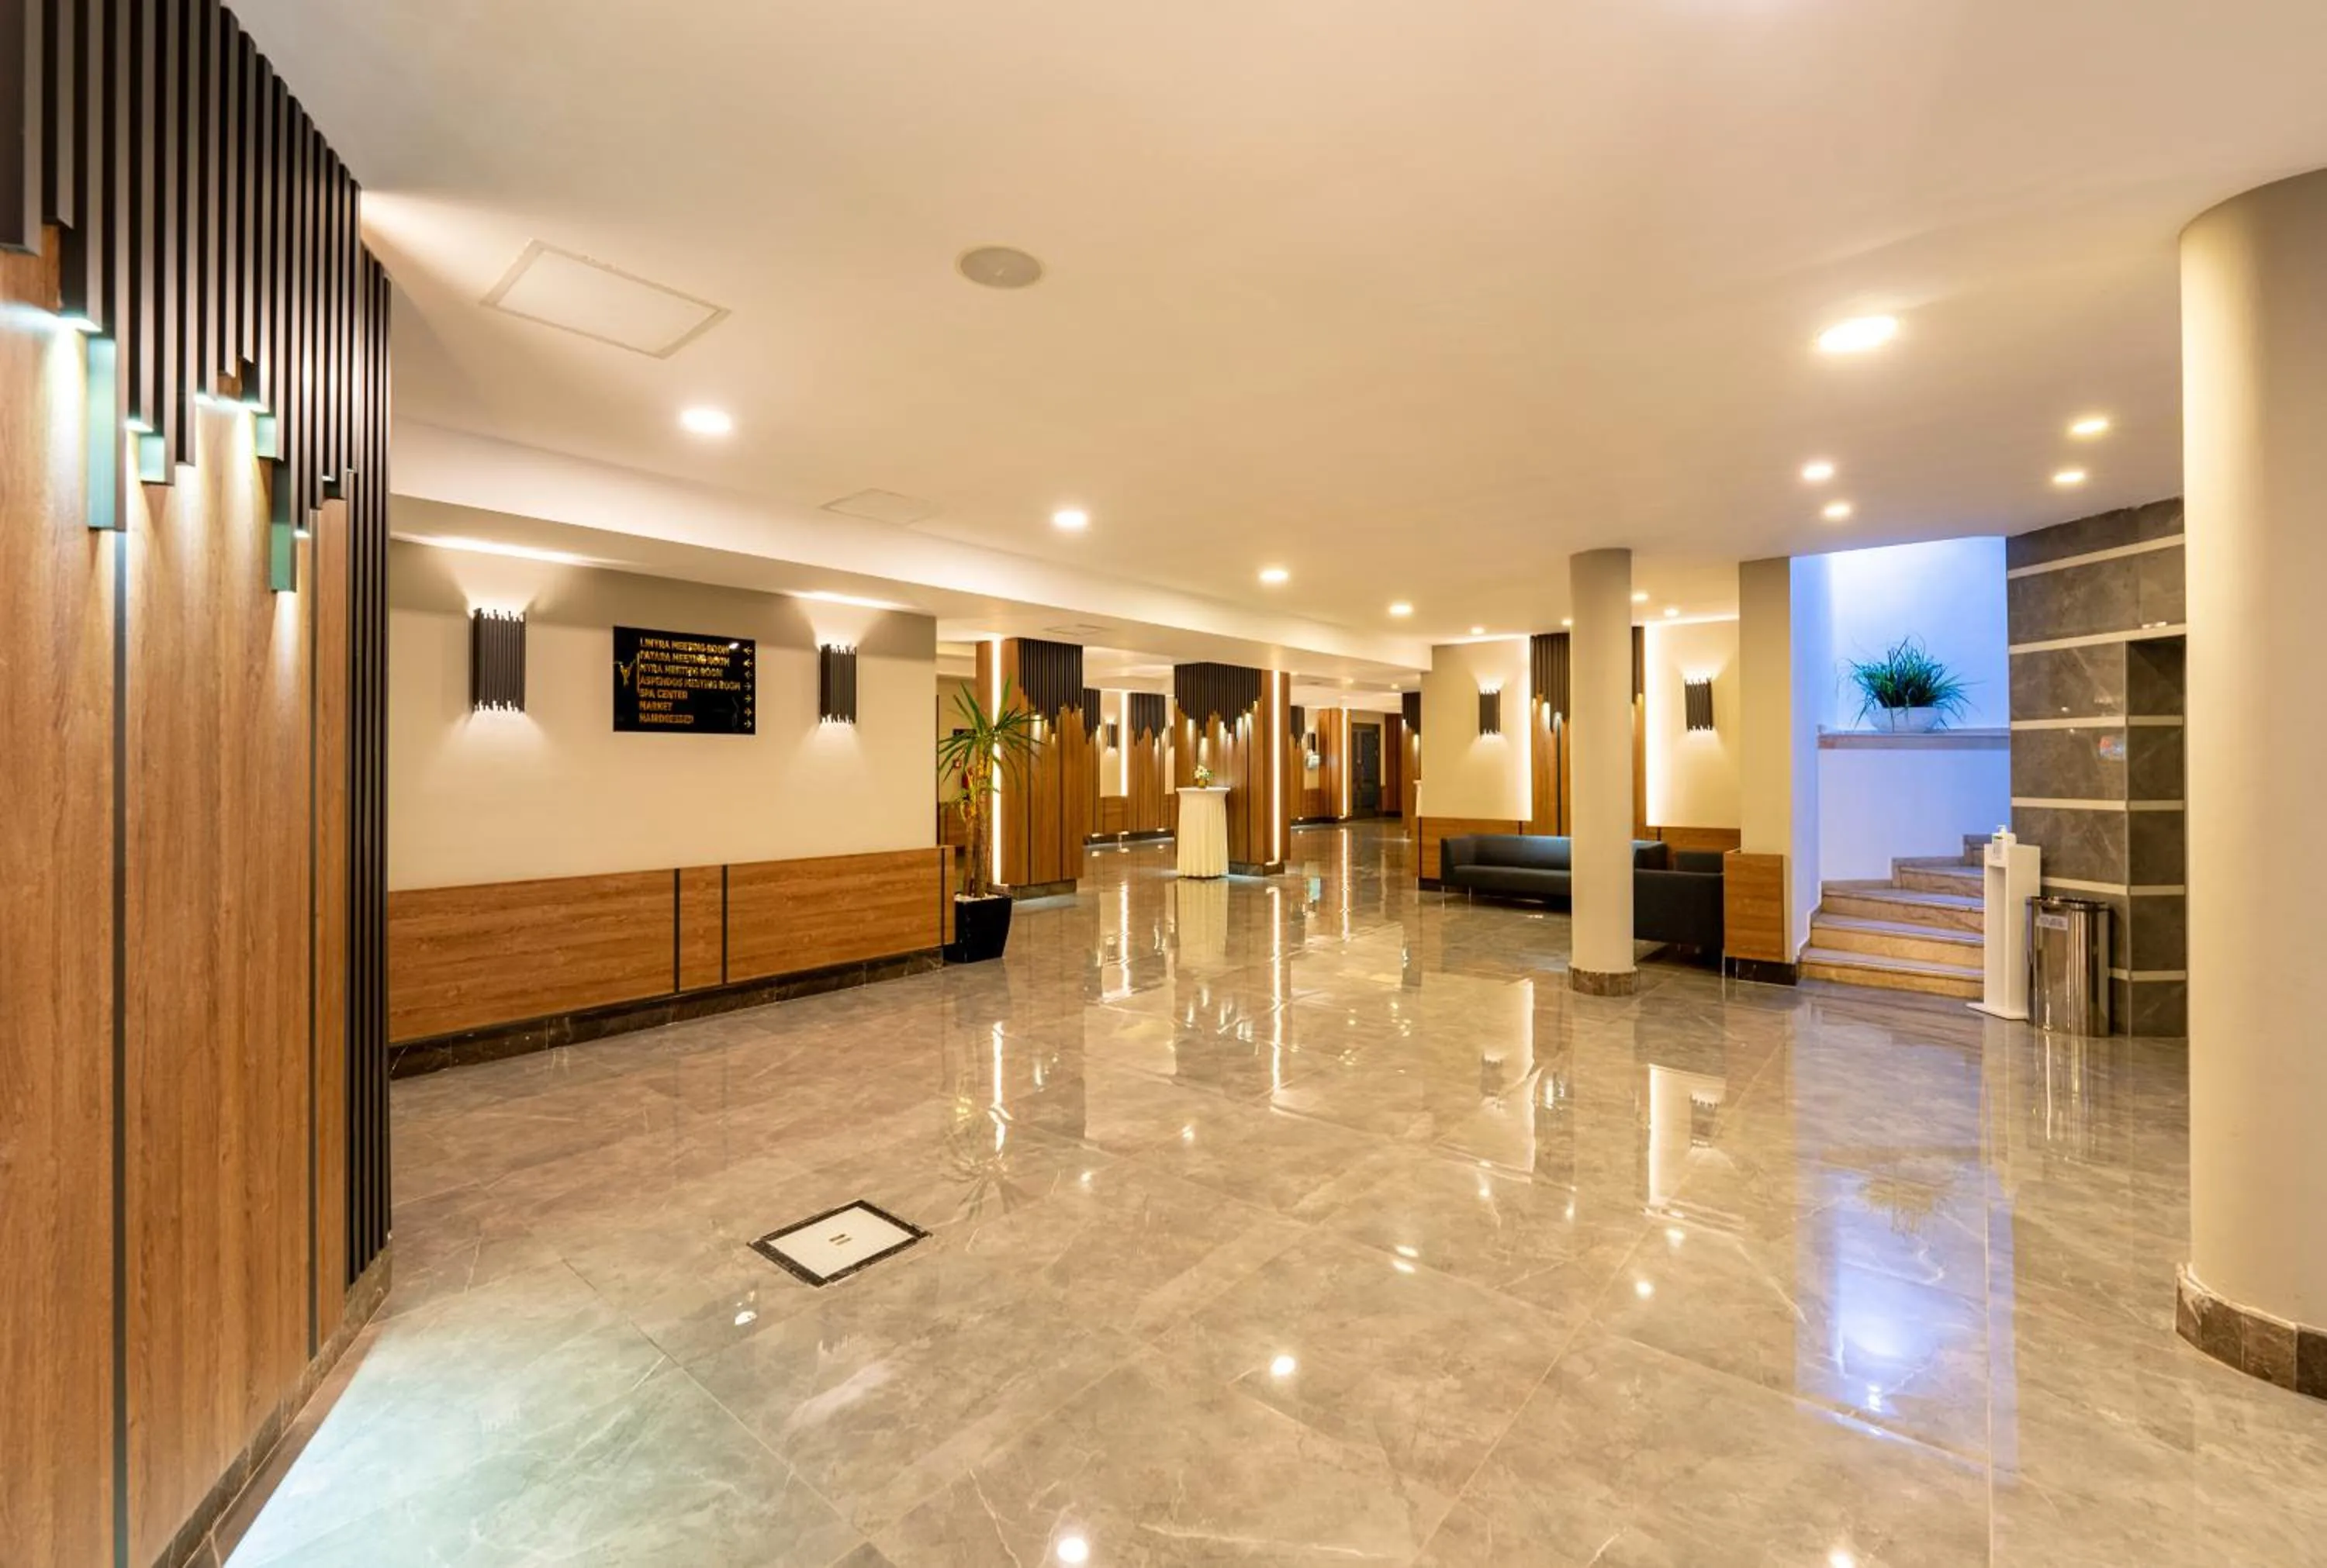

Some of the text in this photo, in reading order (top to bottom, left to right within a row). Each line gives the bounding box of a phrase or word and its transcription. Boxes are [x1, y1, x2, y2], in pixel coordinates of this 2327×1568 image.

[639, 688, 688, 699] SPA CENTER
[639, 700, 673, 711] MARKET
